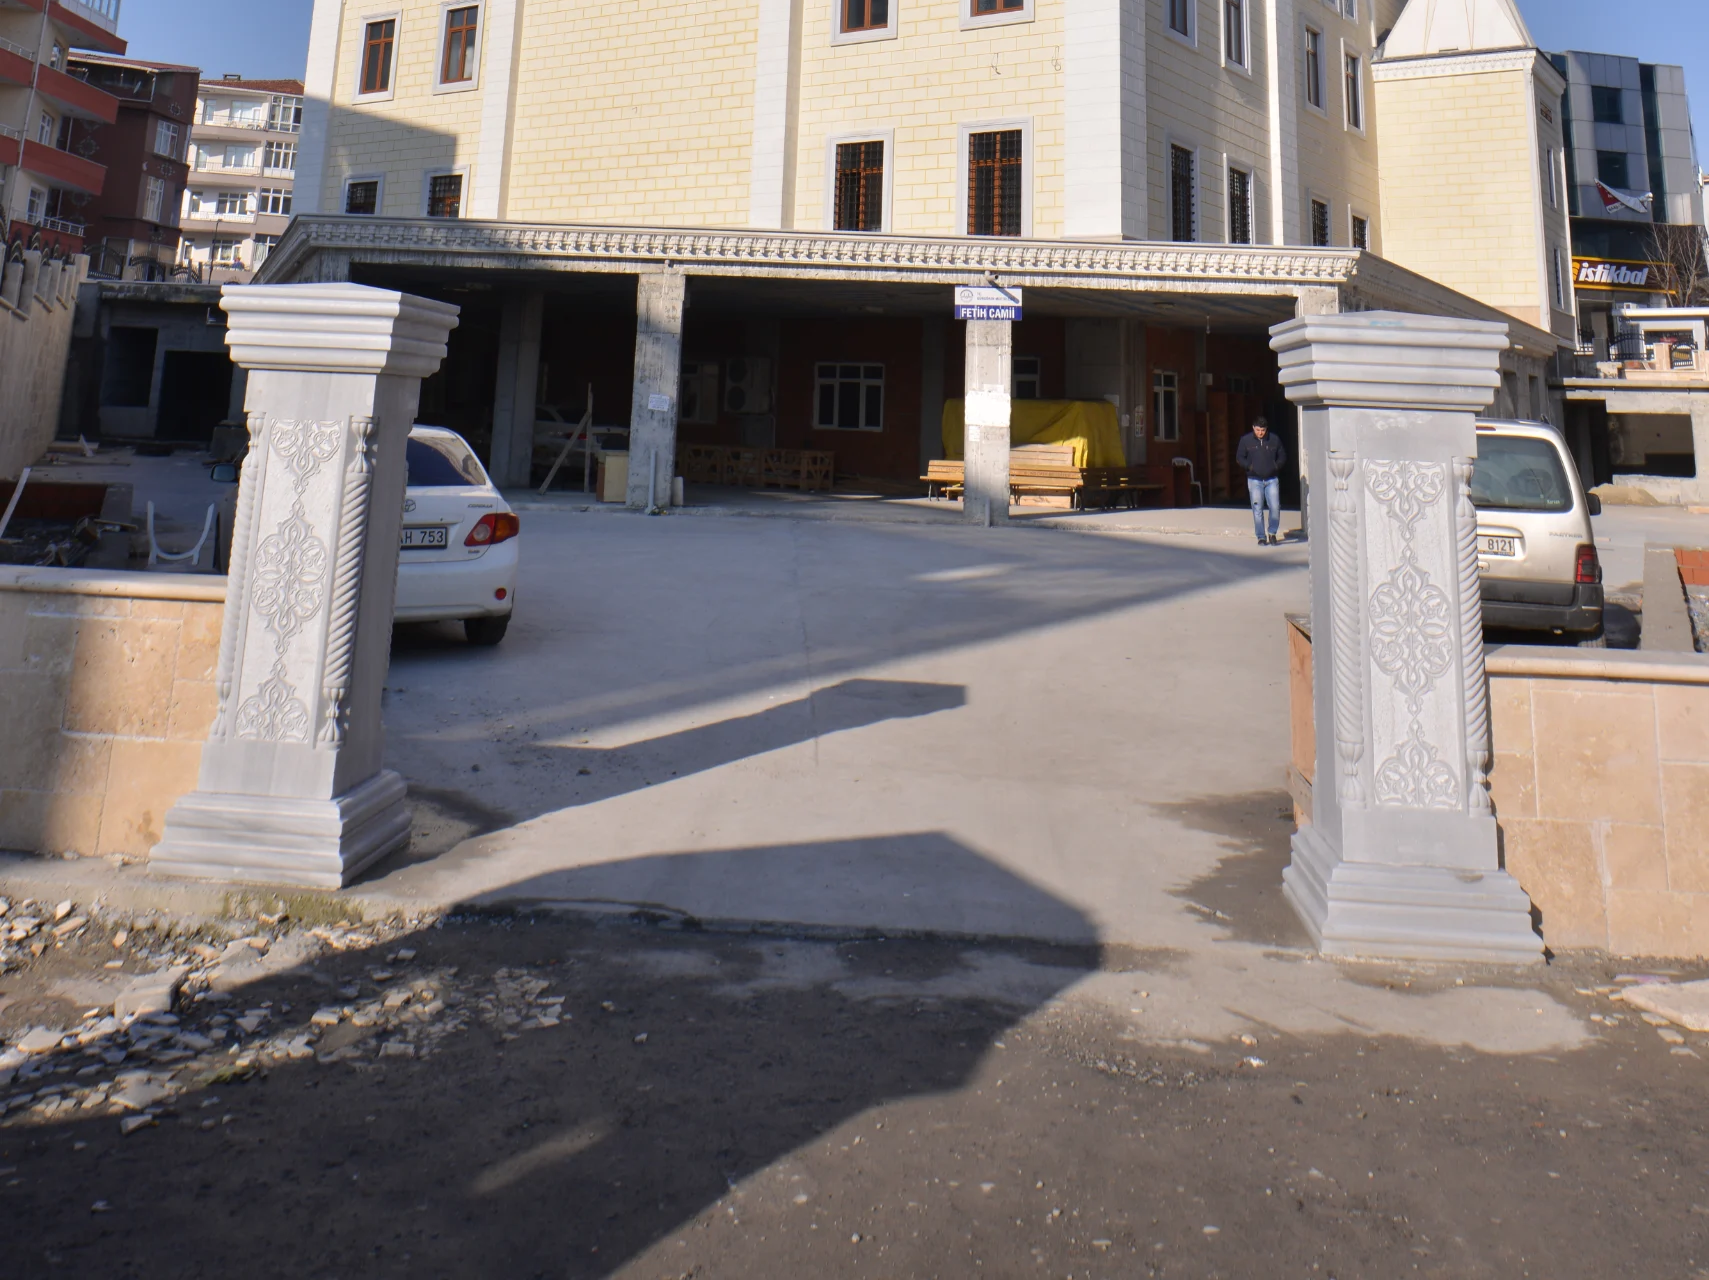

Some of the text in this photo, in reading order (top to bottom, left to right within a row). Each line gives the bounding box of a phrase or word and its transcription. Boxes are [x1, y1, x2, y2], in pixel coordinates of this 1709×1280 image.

[1579, 262, 1650, 285] istikbal
[961, 306, 1015, 319] FETİH CAMİİ
[420, 531, 444, 544] 753
[1487, 538, 1513, 552] 8121
